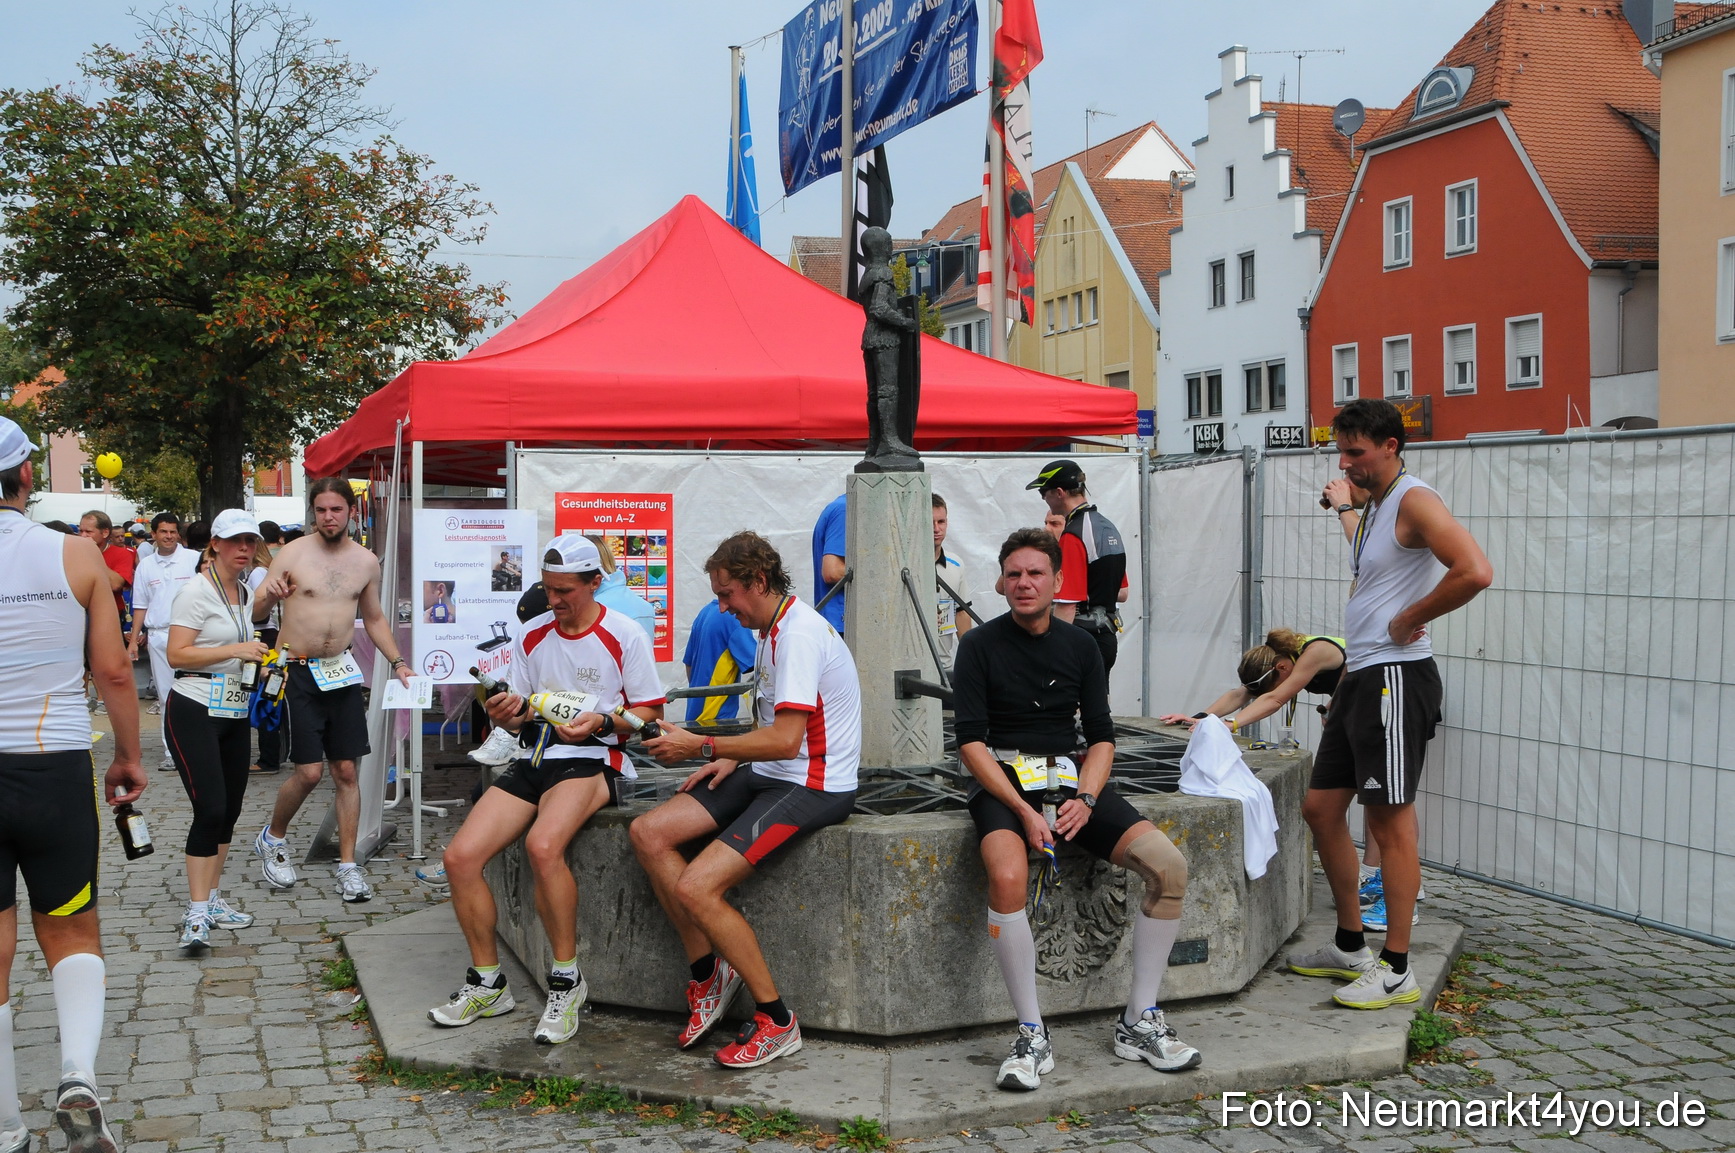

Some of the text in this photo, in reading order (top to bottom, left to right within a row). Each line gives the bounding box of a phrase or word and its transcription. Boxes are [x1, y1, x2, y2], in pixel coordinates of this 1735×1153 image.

[1196, 424, 1219, 441] KBK
[1269, 427, 1301, 440] KBK
[561, 498, 667, 512] Gesundheitsberatung
[445, 533, 507, 541] Leistungsdiagnostik
[434, 561, 484, 569] Ergospirometrie
[458, 597, 516, 605] Laktatbestimmung
[435, 633, 480, 641] Laufband-Test
[478, 657, 491, 674] Neu
[493, 651, 500, 670] in
[325, 664, 354, 679] 2516
[551, 702, 582, 720] 437
